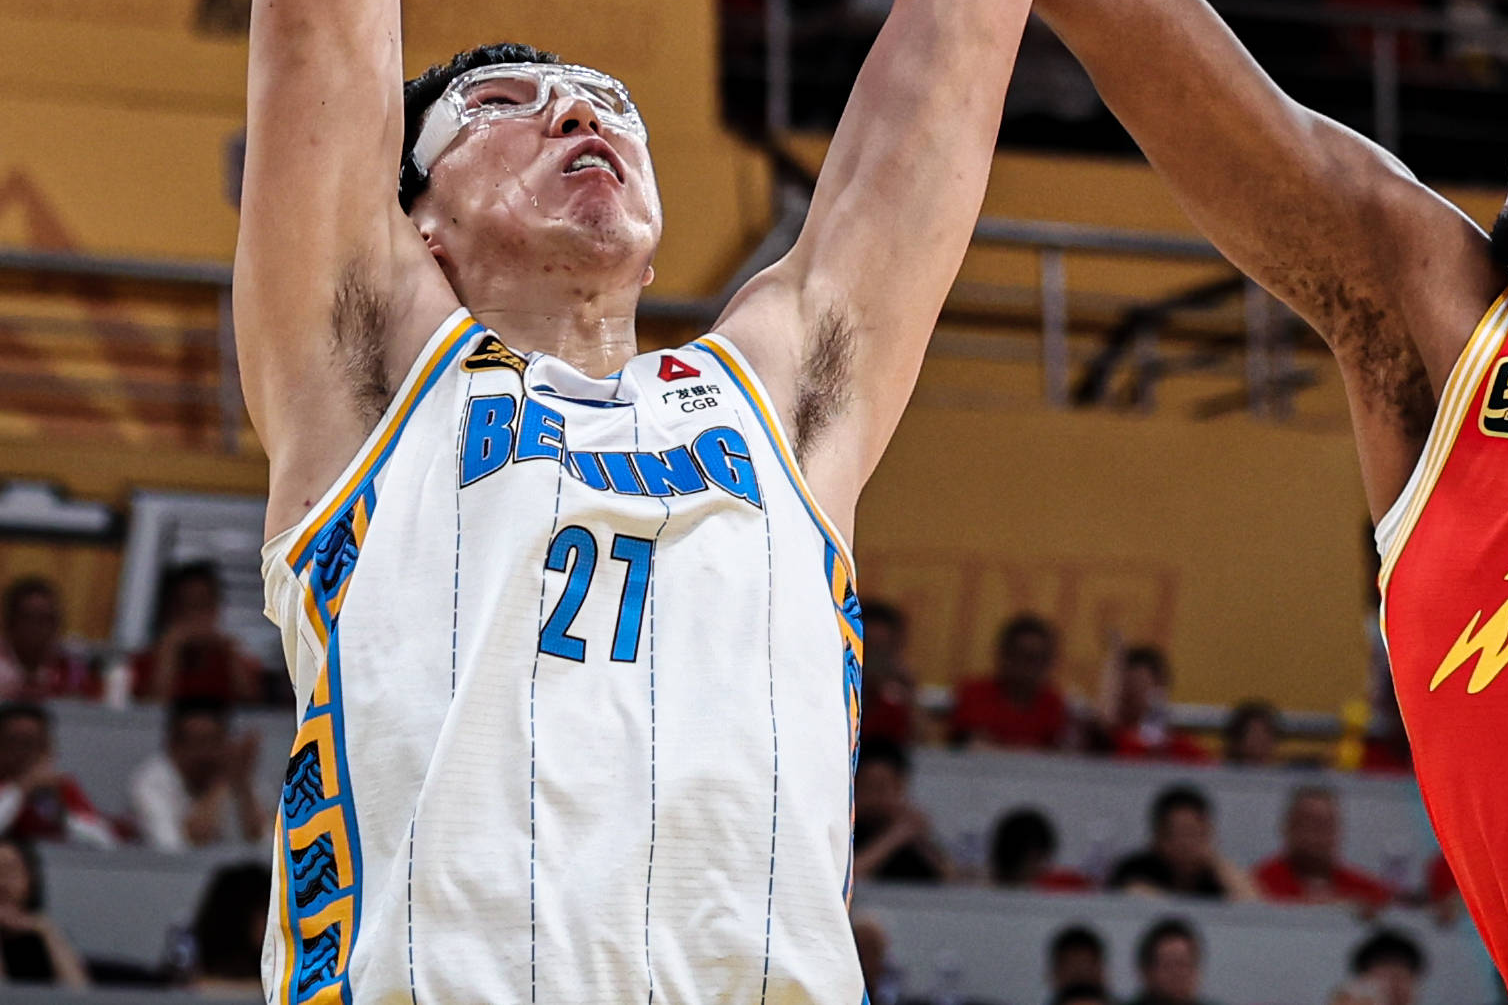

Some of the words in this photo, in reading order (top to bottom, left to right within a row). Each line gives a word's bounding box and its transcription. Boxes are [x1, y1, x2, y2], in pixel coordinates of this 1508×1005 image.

[662, 384, 721, 404] 广发银行
[681, 397, 718, 413] CGB
[459, 393, 763, 510] BEJING
[538, 524, 655, 664] 27
